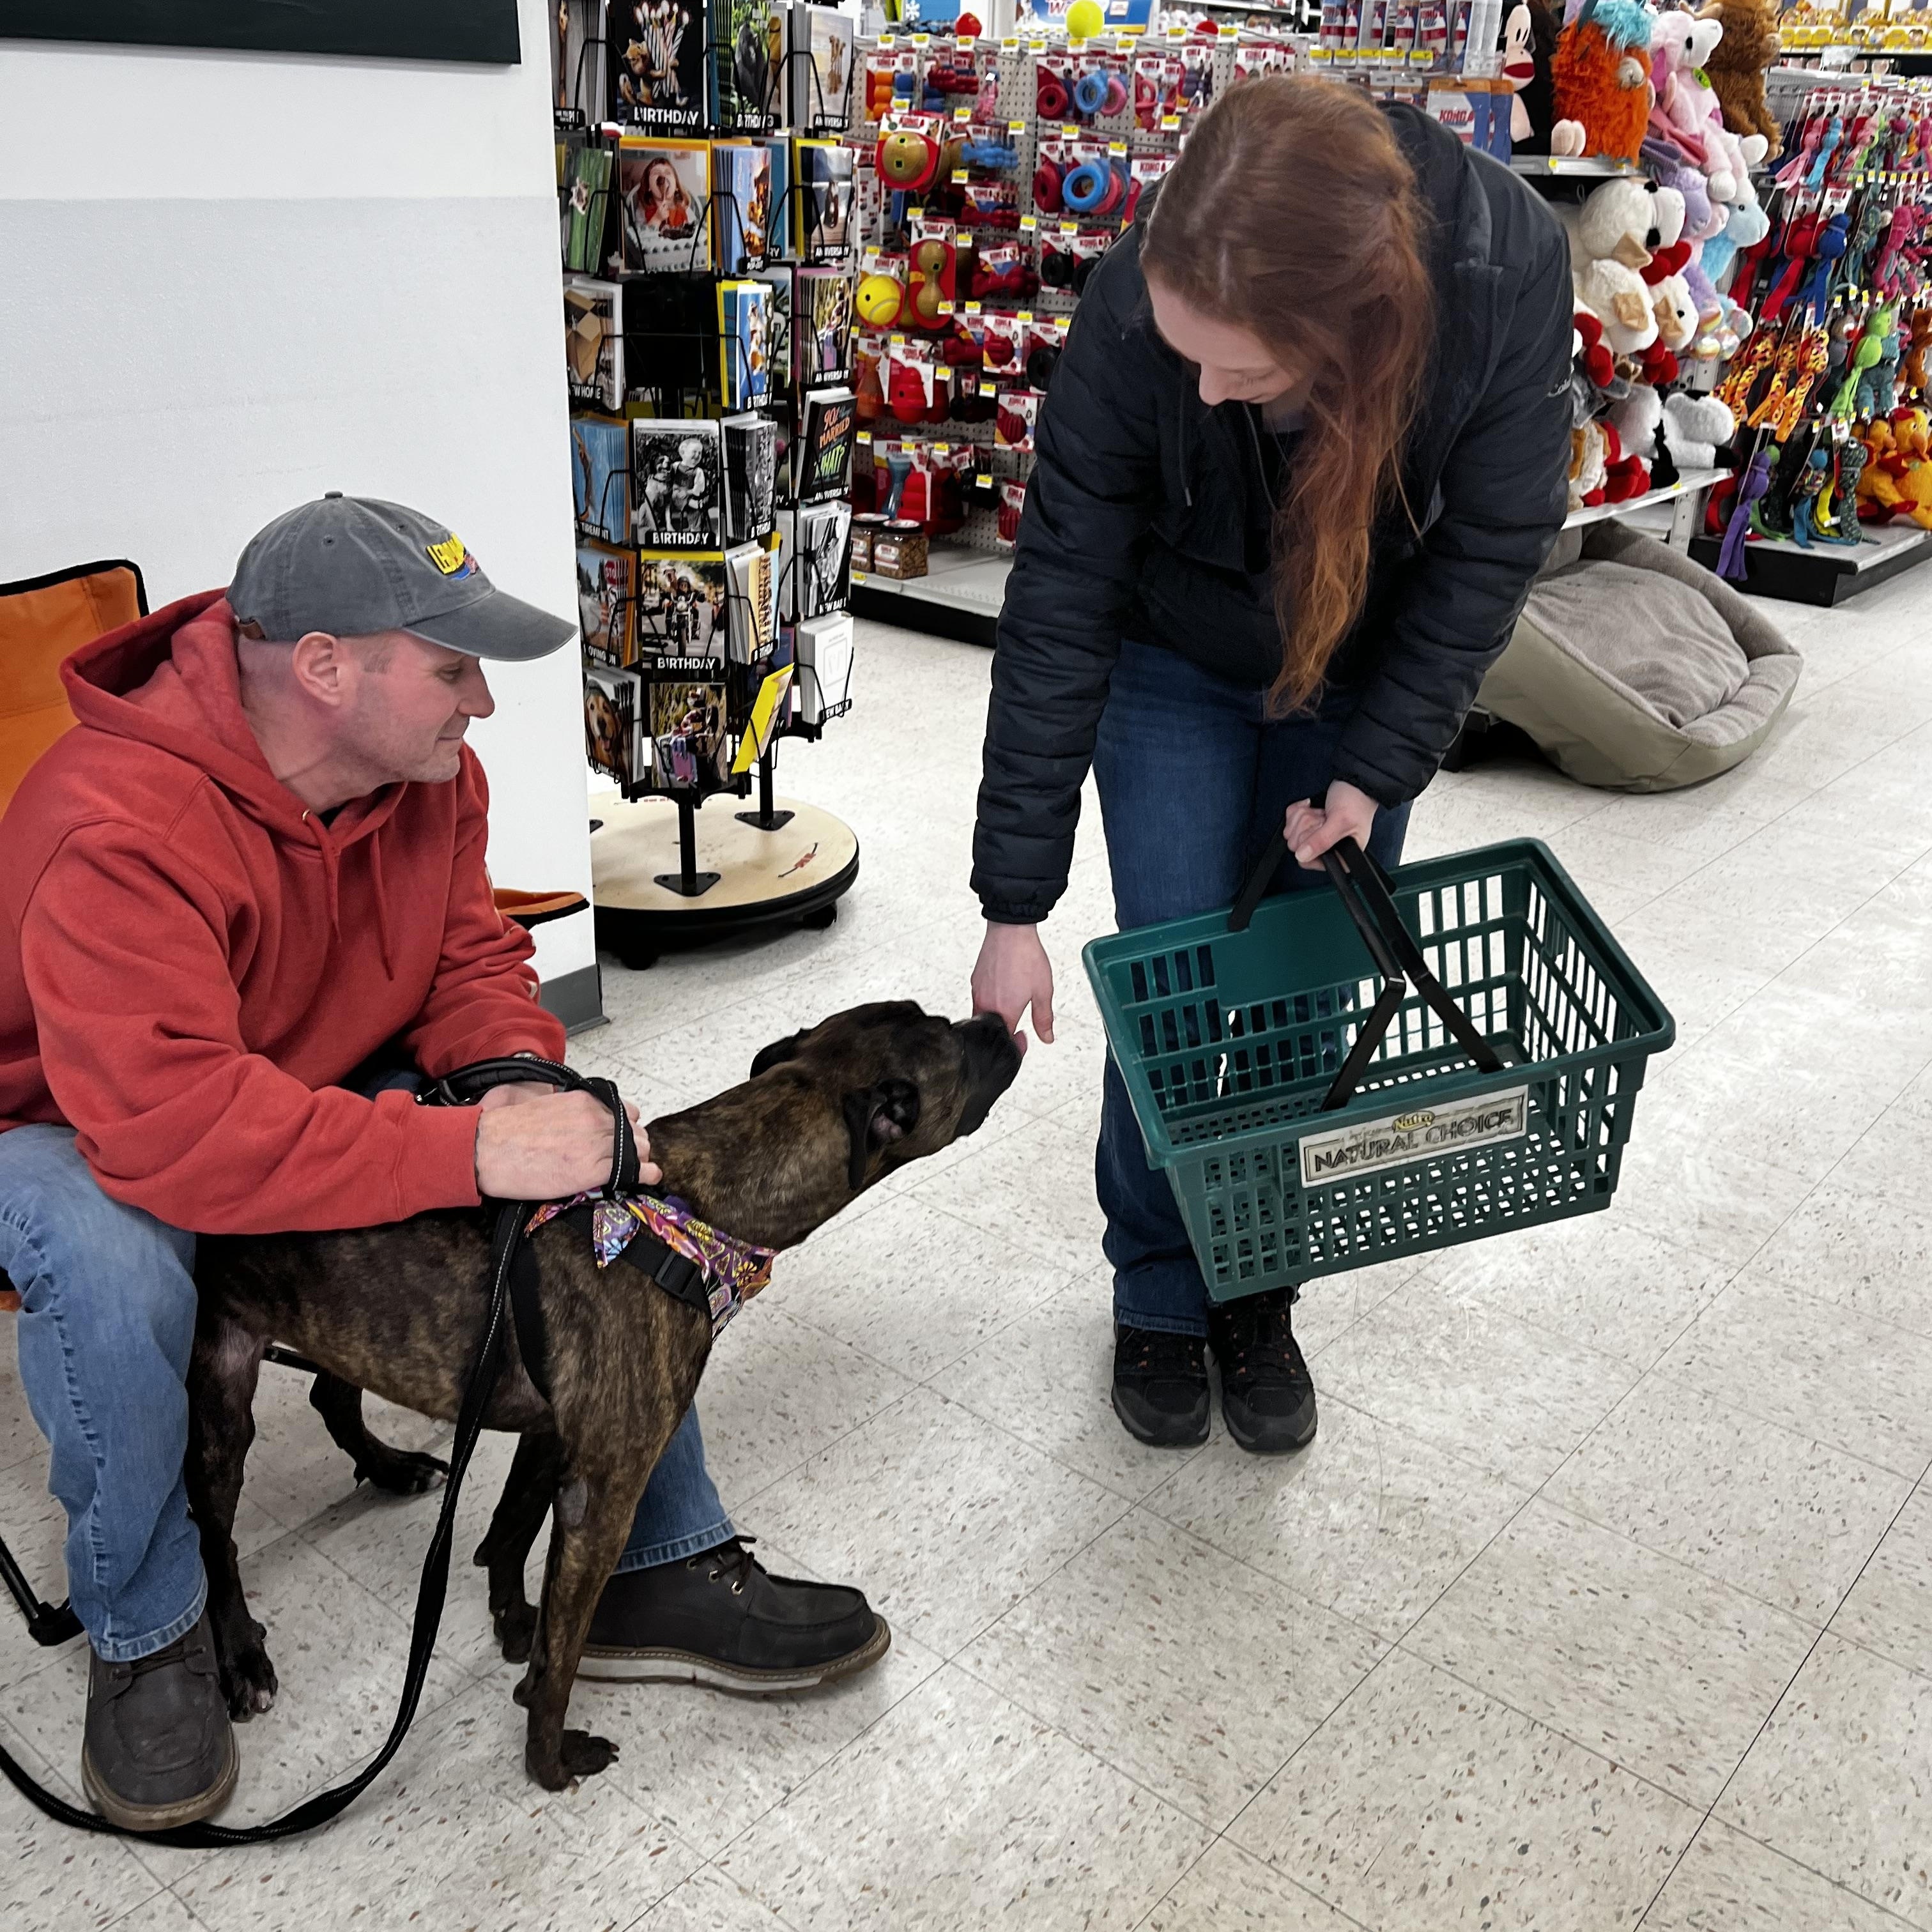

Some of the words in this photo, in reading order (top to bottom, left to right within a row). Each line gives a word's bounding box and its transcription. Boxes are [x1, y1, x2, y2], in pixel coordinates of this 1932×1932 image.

[634, 106, 699, 125] BIRTHDAY
[1439, 109, 1466, 121] KONG
[653, 532, 709, 544] BIRTHDAY
[657, 657, 716, 670] BIRTHDAY
[1314, 1132, 1418, 1172] NATURAL
[1426, 1109, 1514, 1143] CHOICE
